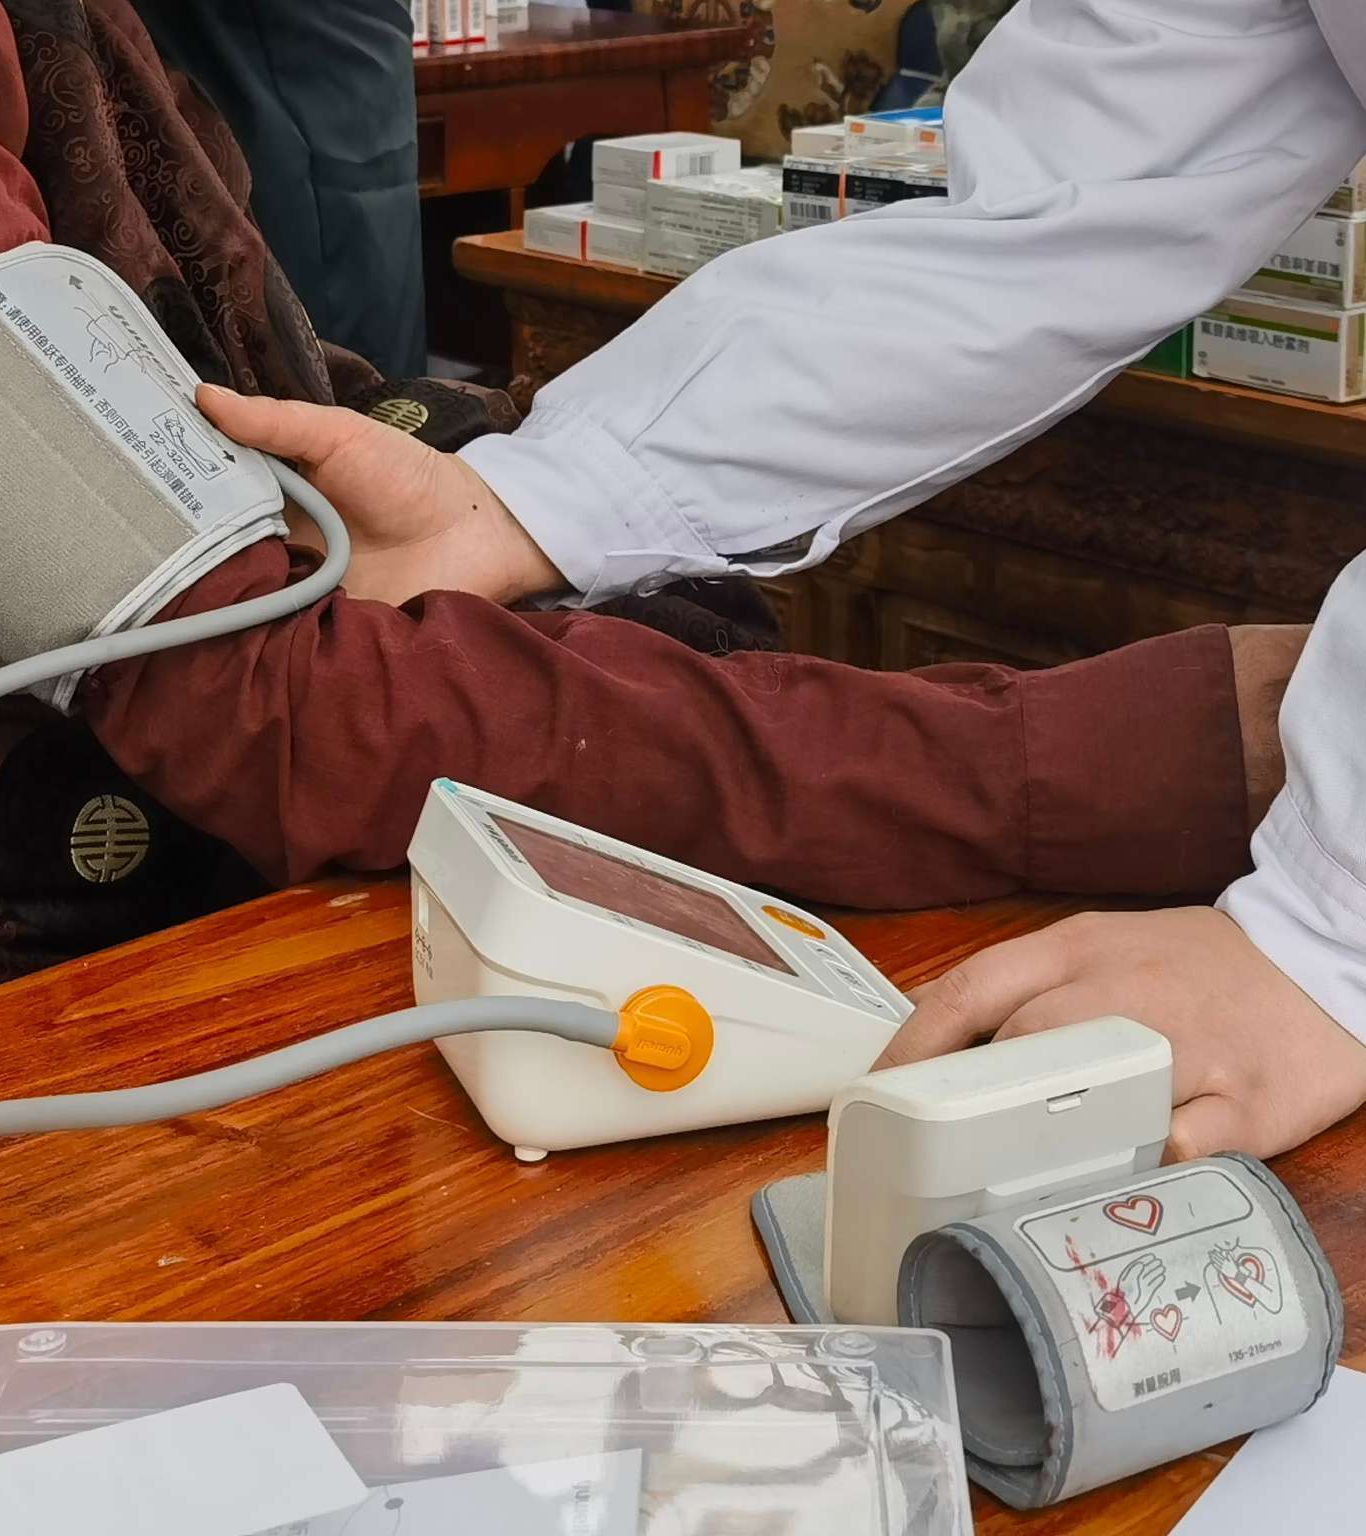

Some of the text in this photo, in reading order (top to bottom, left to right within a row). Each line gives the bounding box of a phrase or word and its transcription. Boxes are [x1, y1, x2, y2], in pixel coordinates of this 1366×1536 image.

[149, 431, 196, 480] 22-32cm
[1132, 1368, 1181, 1397] 测量腕周
